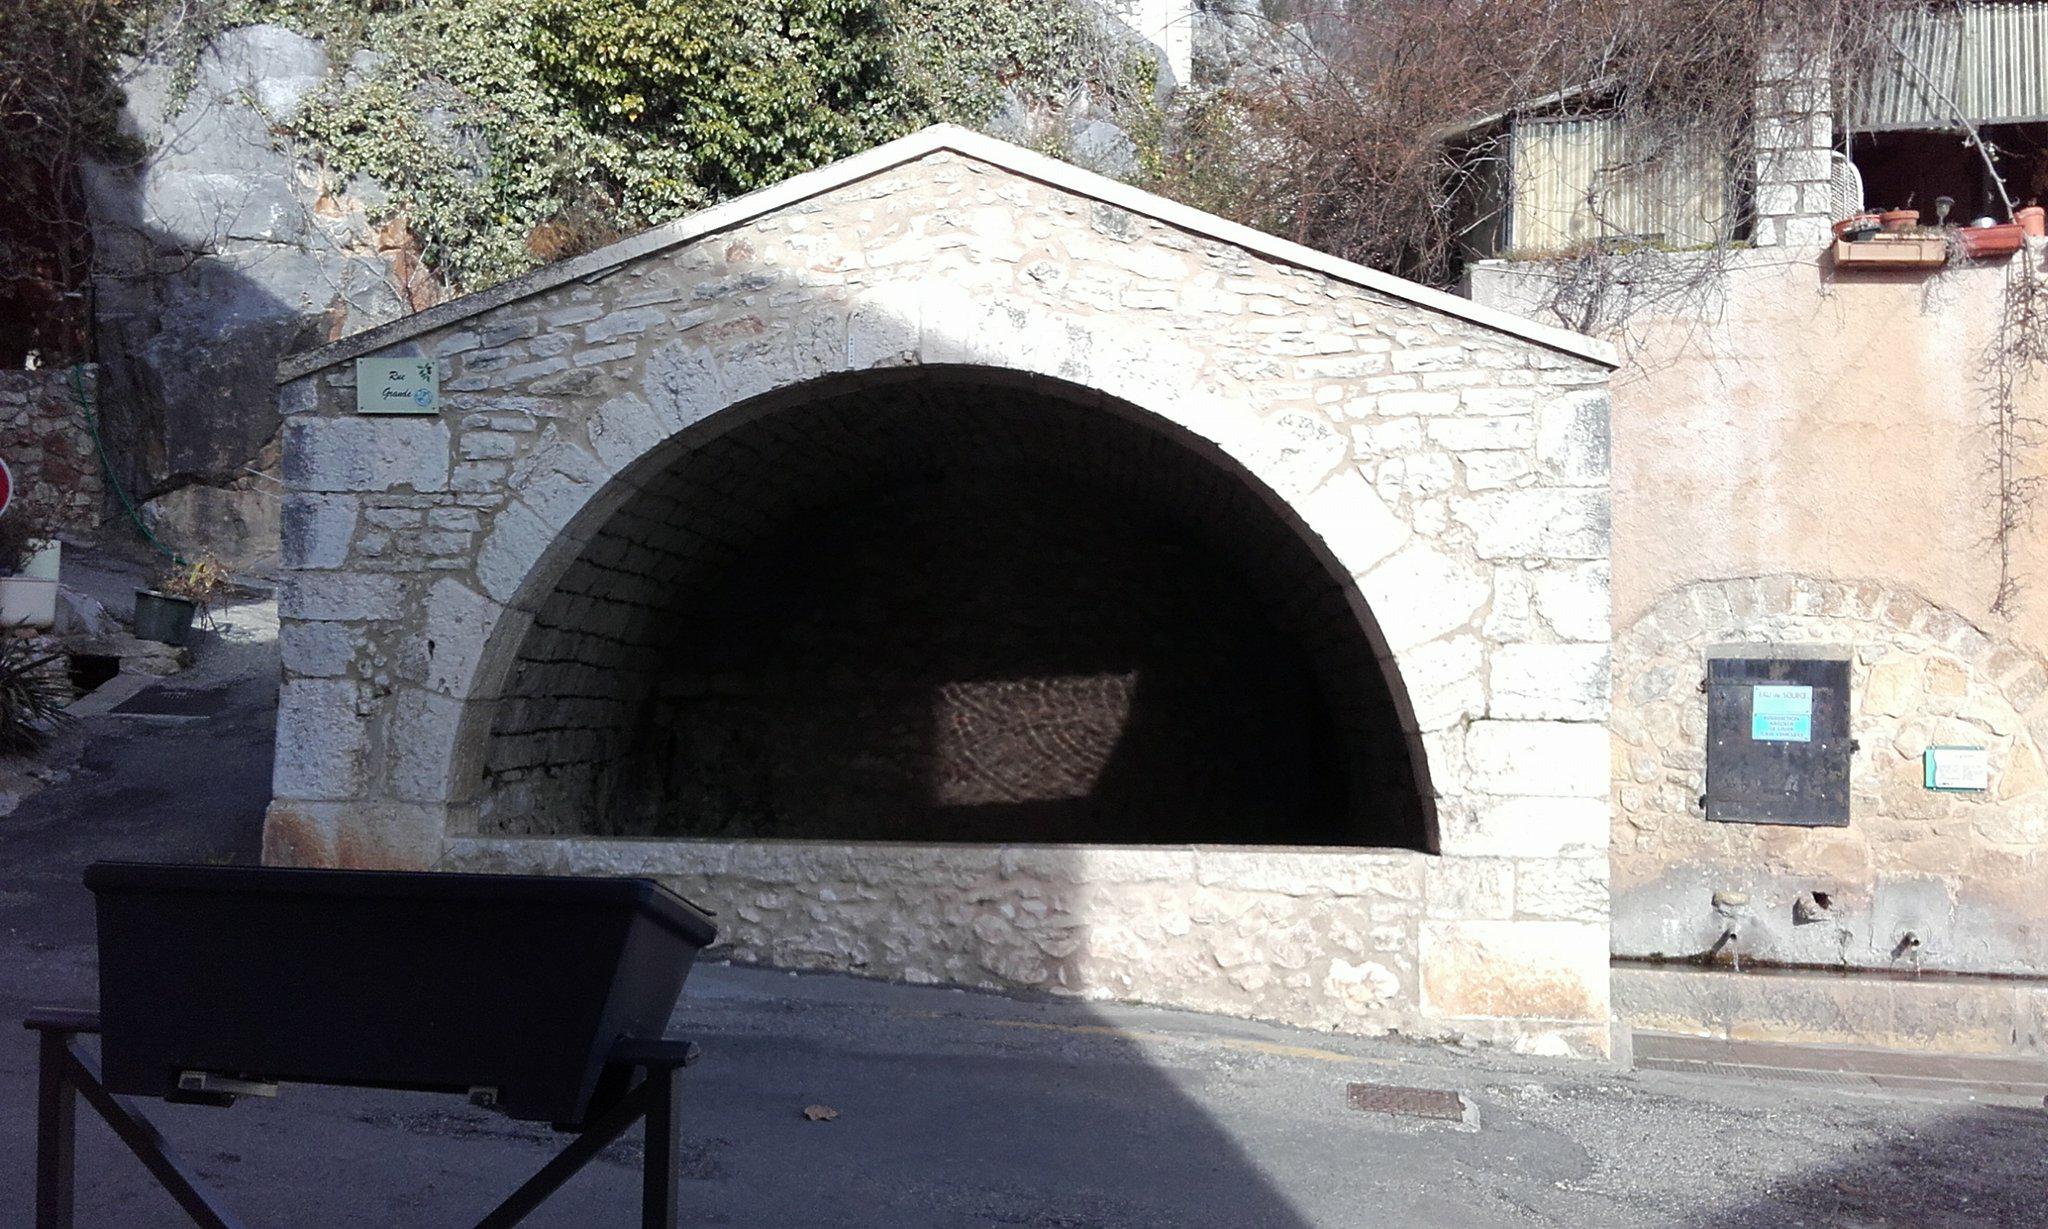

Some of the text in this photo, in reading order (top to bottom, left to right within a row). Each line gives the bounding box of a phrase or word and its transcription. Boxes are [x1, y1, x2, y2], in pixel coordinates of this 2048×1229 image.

[388, 370, 406, 381] Rue
[382, 387, 412, 400] Grande
[1783, 691, 1806, 699] SOURCE
